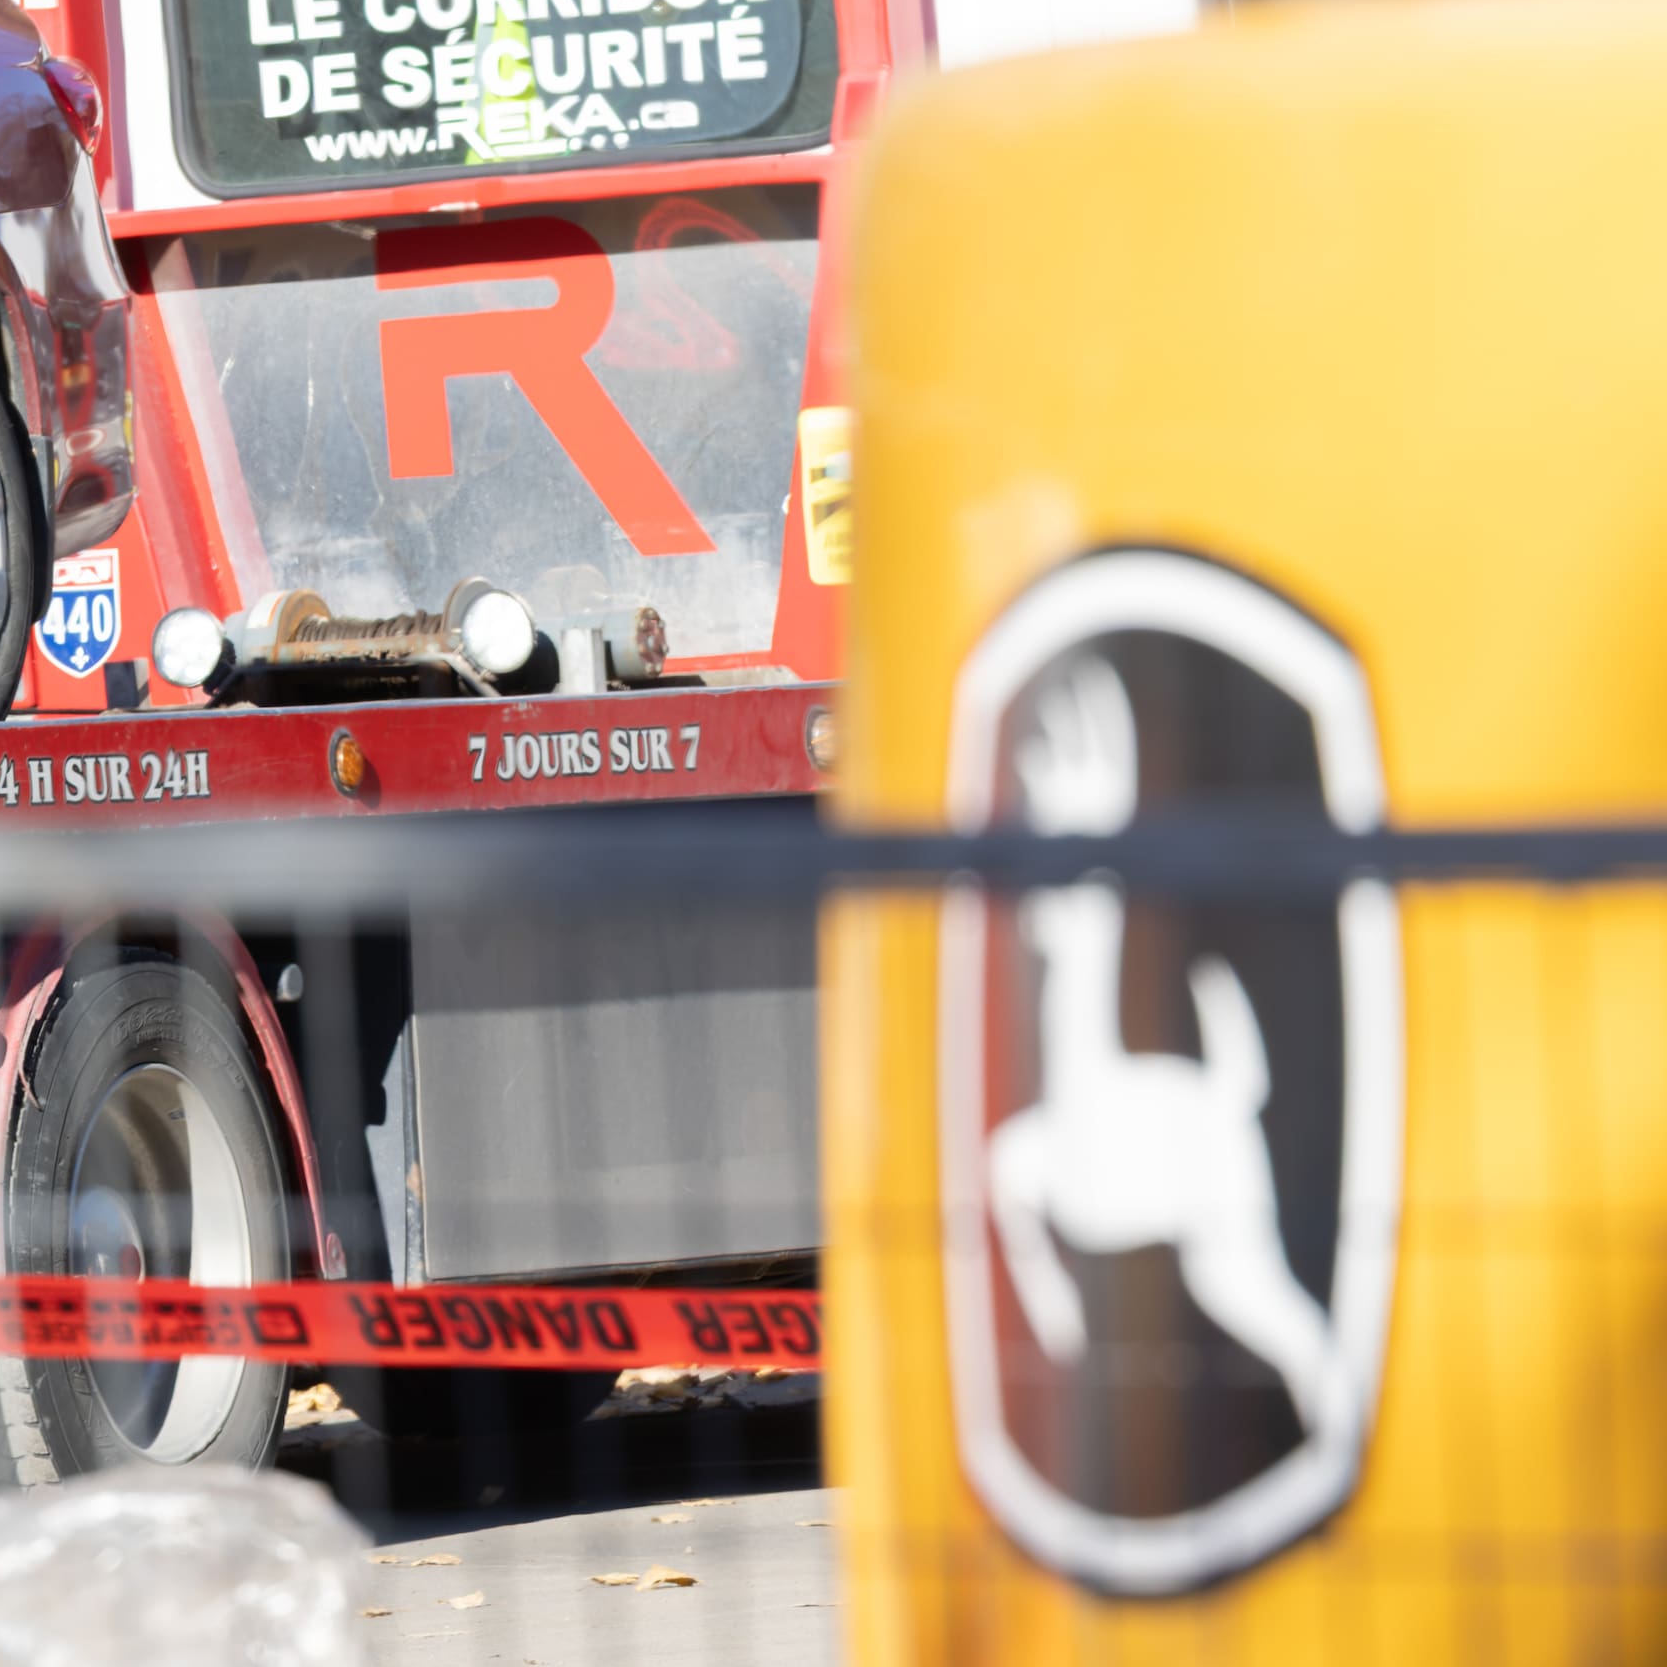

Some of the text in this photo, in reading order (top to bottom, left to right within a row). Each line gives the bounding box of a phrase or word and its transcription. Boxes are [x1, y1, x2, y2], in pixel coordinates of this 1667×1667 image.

[258, 5, 769, 119] DE SÉCURITÉ
[376, 215, 717, 557] R
[43, 594, 113, 644] 440
[28, 757, 55, 805] H
[64, 755, 135, 804] SUR
[140, 748, 211, 803] 24H
[468, 724, 700, 781] 7 JOURS SUR 7
[349, 1294, 637, 1351] DANGER
[672, 1299, 821, 1354] GER
